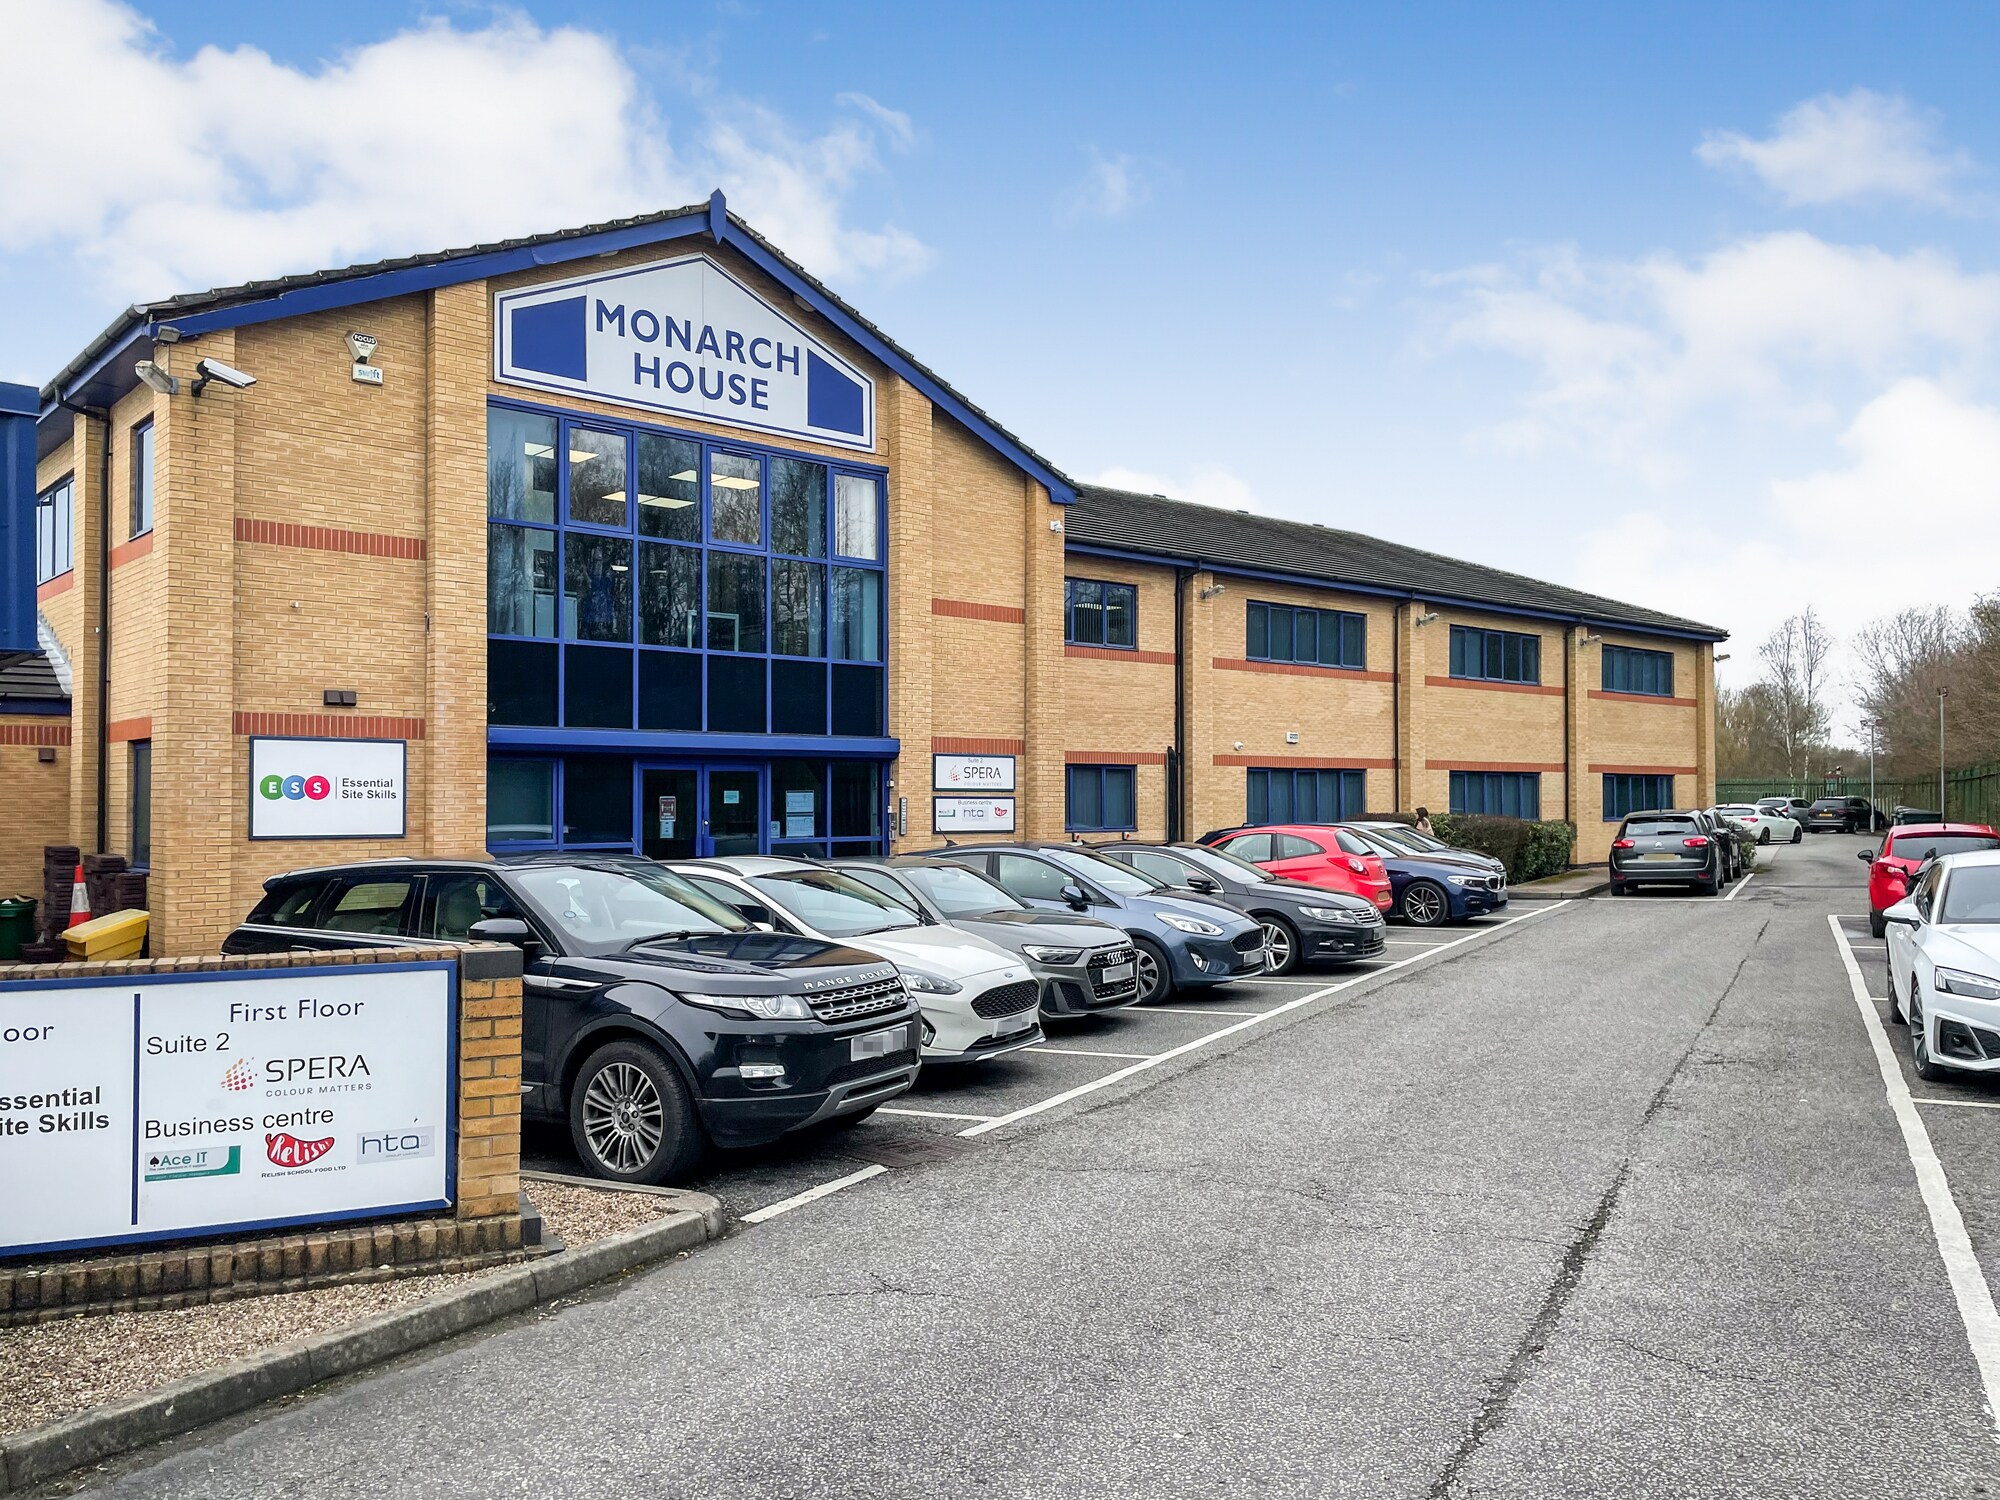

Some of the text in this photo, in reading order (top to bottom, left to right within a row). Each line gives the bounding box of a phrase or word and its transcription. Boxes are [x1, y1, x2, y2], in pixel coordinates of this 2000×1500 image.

[354, 334, 375, 344] FOCUS
[596, 299, 799, 376] MONARCH
[634, 352, 769, 411] HOUSE
[342, 778, 393, 788] Essential
[963, 767, 1001, 779] SPERA
[342, 789, 397, 799] Site Skills
[803, 967, 894, 990] RANGE ROVER
[230, 999, 364, 1022] First Floor
[3, 1025, 54, 1042] oor
[146, 1032, 230, 1055] Suite 2
[265, 1055, 371, 1083] SPERA
[266, 1083, 372, 1097] COLOUR MATTERS
[38, 1111, 110, 1133] Skills
[145, 1107, 334, 1139] Business centre
[362, 1134, 419, 1155] hta
[160, 1151, 208, 1167] Ace IT
